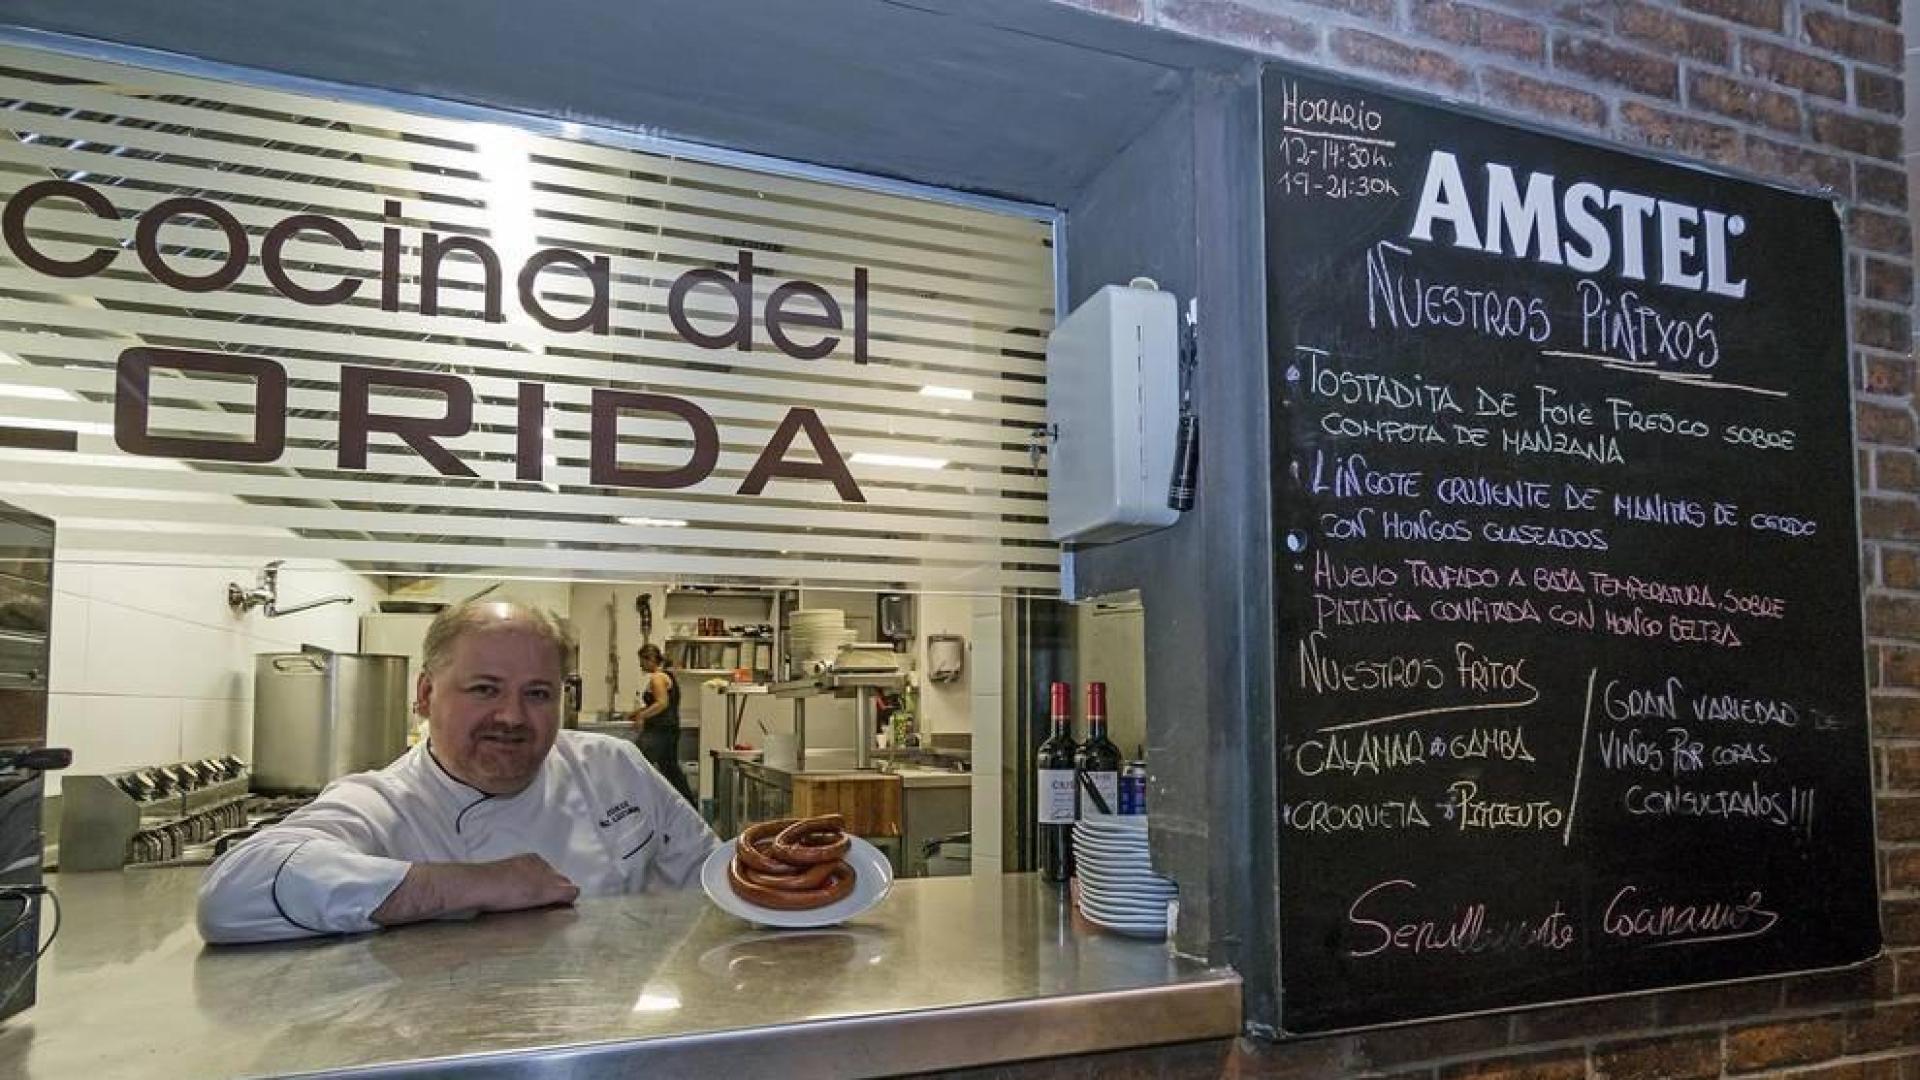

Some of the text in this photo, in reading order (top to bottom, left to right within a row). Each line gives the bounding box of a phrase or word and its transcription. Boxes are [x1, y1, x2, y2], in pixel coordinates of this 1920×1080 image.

[3, 179, 868, 365] cocina del
[1367, 240, 1550, 342] NUESTROS
[1321, 412, 1626, 465] COMPOTA DE MANZANA
[1475, 386, 1518, 417] DE
[1606, 397, 1710, 438] FRESCO
[1723, 424, 1796, 451] SOBRE
[1313, 449, 1424, 498] LINGOTE
[1565, 483, 1603, 511] DE
[1614, 493, 1706, 528] MANITAS
[1714, 503, 1740, 526] DE
[1751, 513, 1817, 536] CERDO
[1321, 507, 1609, 551] CON HONGOS GLASEADOS
[1315, 549, 1398, 590] HUEVO
[1404, 559, 1501, 590] TRUFADO
[1508, 567, 1527, 588] A
[1534, 567, 1585, 593] BAJA
[1724, 589, 1785, 620] SOBRE
[1313, 593, 1422, 631] PATATICA
[1430, 597, 1542, 624] CONFITADA
[1550, 600, 1595, 630] CON
[1605, 606, 1663, 637] HONGO
[1300, 631, 1538, 700] NUESTROS FRITOS
[1604, 677, 1683, 721] GRAN
[1693, 696, 1799, 727] VARIEDAD
[1297, 726, 1537, 777] CALAMAR GAMBA
[1291, 799, 1431, 833] CROQUETA
